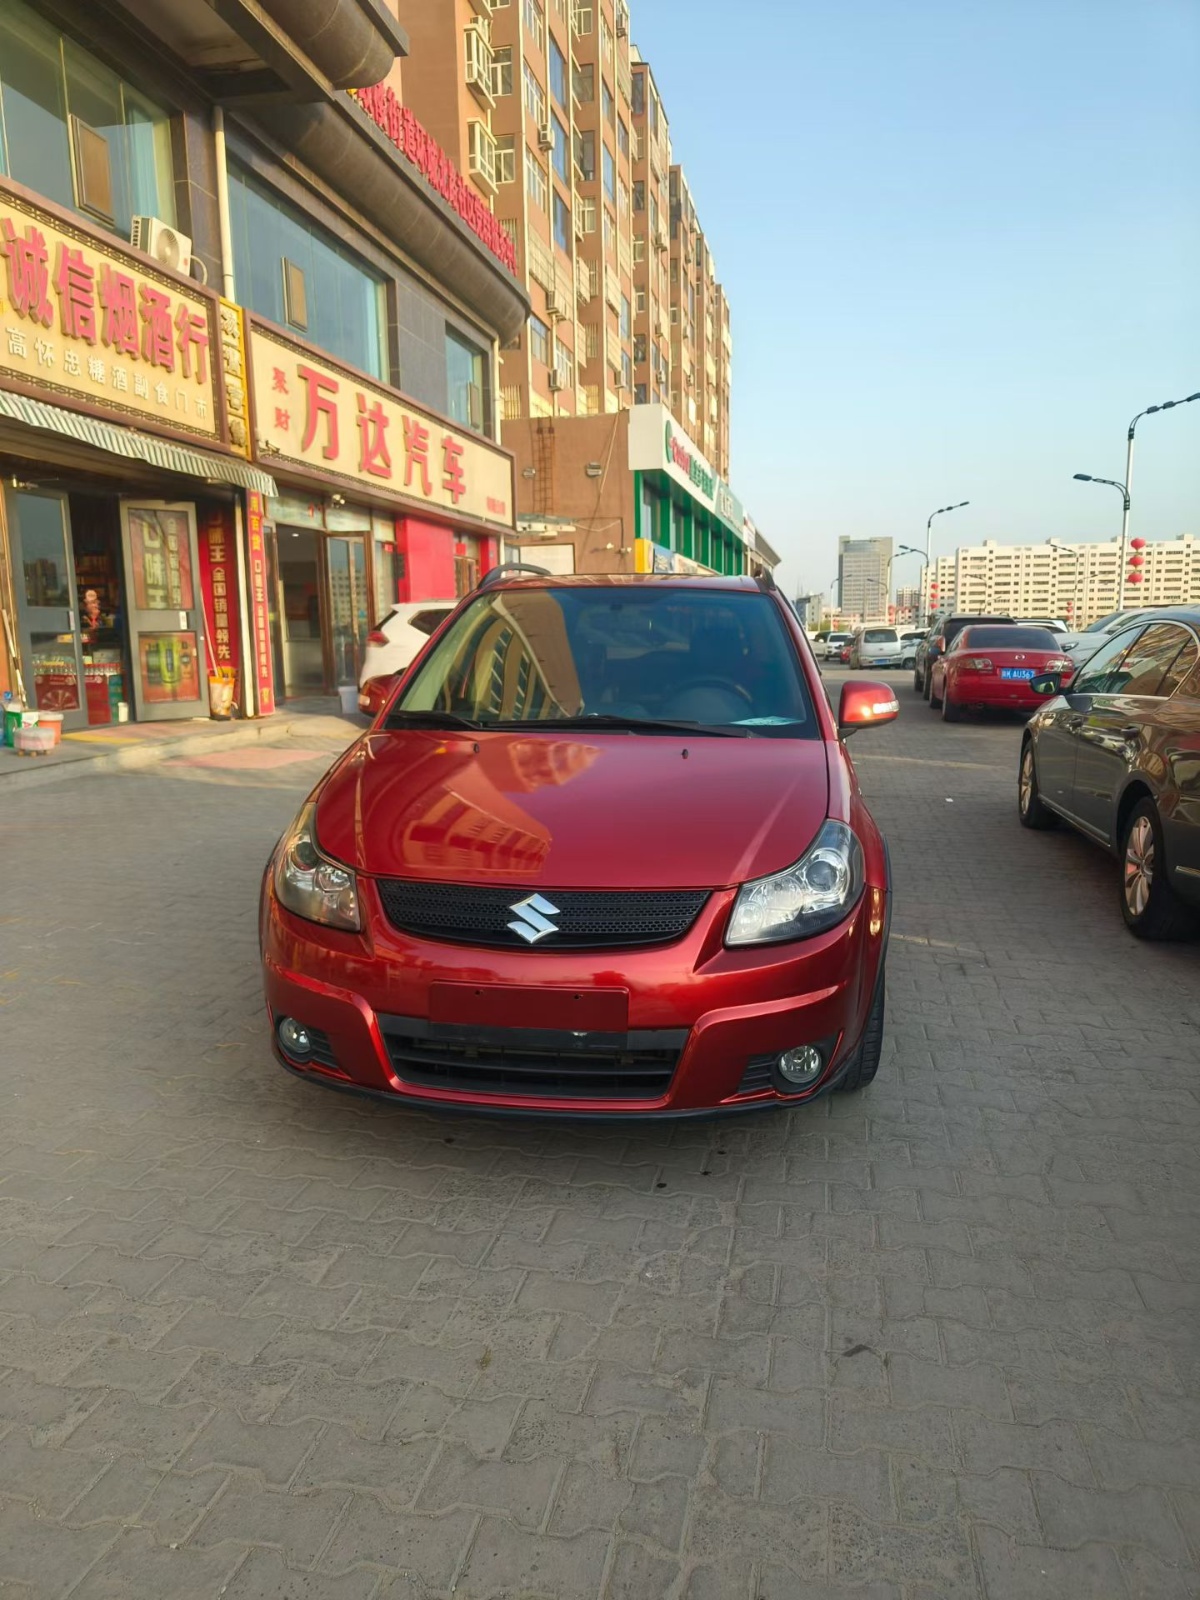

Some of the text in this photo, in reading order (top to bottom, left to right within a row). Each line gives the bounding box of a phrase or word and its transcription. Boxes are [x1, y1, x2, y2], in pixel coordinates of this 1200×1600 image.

[1, 217, 209, 385] 诚信烟酒行
[297, 363, 467, 505] 万达汽车
